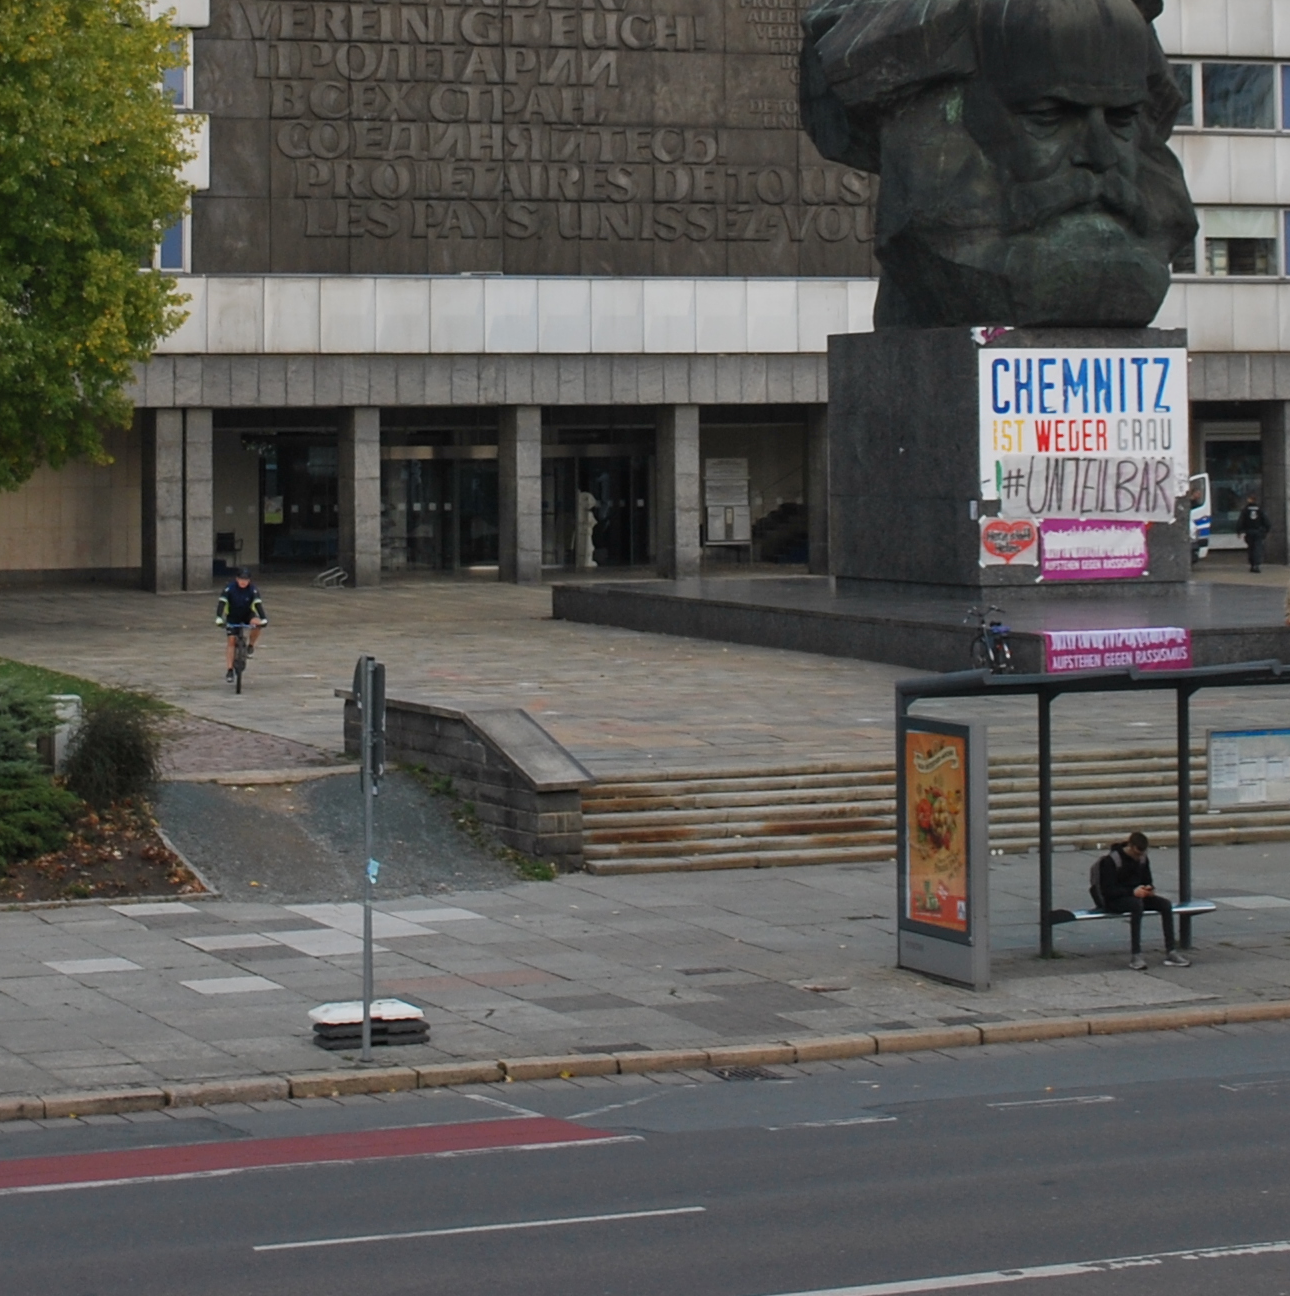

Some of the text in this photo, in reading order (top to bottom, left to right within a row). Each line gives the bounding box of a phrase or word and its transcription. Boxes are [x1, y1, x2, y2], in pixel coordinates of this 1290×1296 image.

[231, 1, 707, 52] VEREINIGT EUCH!
[747, 9, 797, 26] ALLER
[255, 40, 620, 88] ПРОЛЕТАРИИ
[270, 80, 608, 128] ВСЕХ СТРАН,
[275, 121, 727, 165] СОЕДИНЯЙТЕСЬ!
[294, 160, 874, 206] PROLETAIRES DE TOUS
[303, 197, 400, 239] LES
[992, 357, 1171, 414] CHEMNITZ
[993, 420, 1025, 452] IST
[1117, 418, 1172, 451] GRAU
[1002, 456, 1172, 515] #UNTEILBAR
[1052, 646, 1188, 669] AUFSTEHEN GEGEN RASSISMUS
